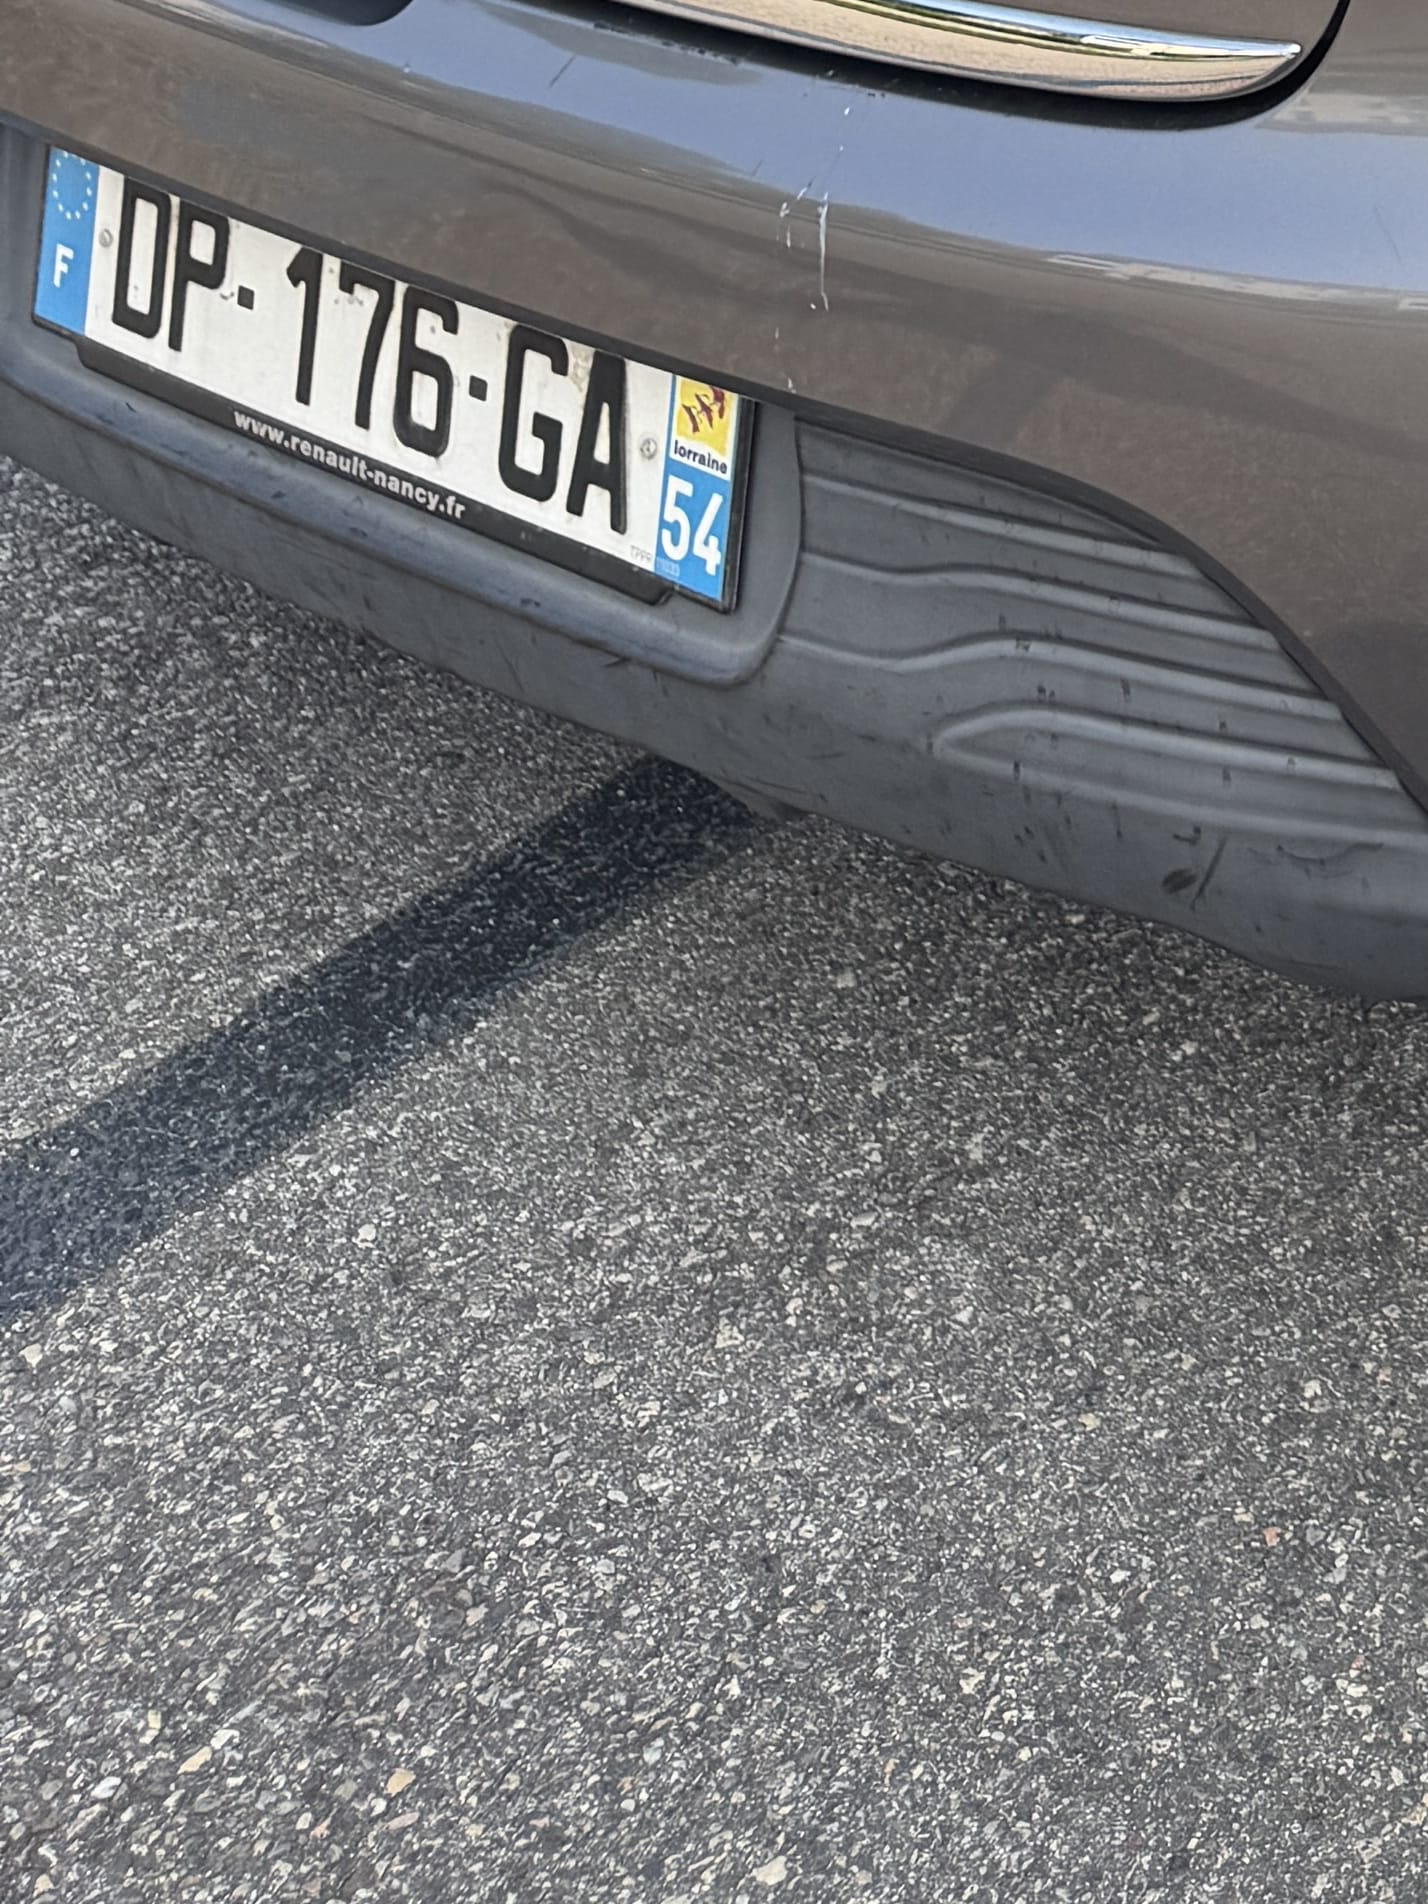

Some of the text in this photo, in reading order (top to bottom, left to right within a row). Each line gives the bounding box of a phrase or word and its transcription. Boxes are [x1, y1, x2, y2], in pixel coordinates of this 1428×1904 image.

[52, 242, 75, 289] F
[112, 176, 627, 536] DP-176-GA
[233, 410, 467, 521] www.renault-nancy.fr
[674, 438, 728, 475] lorraine
[661, 474, 722, 577] 54
